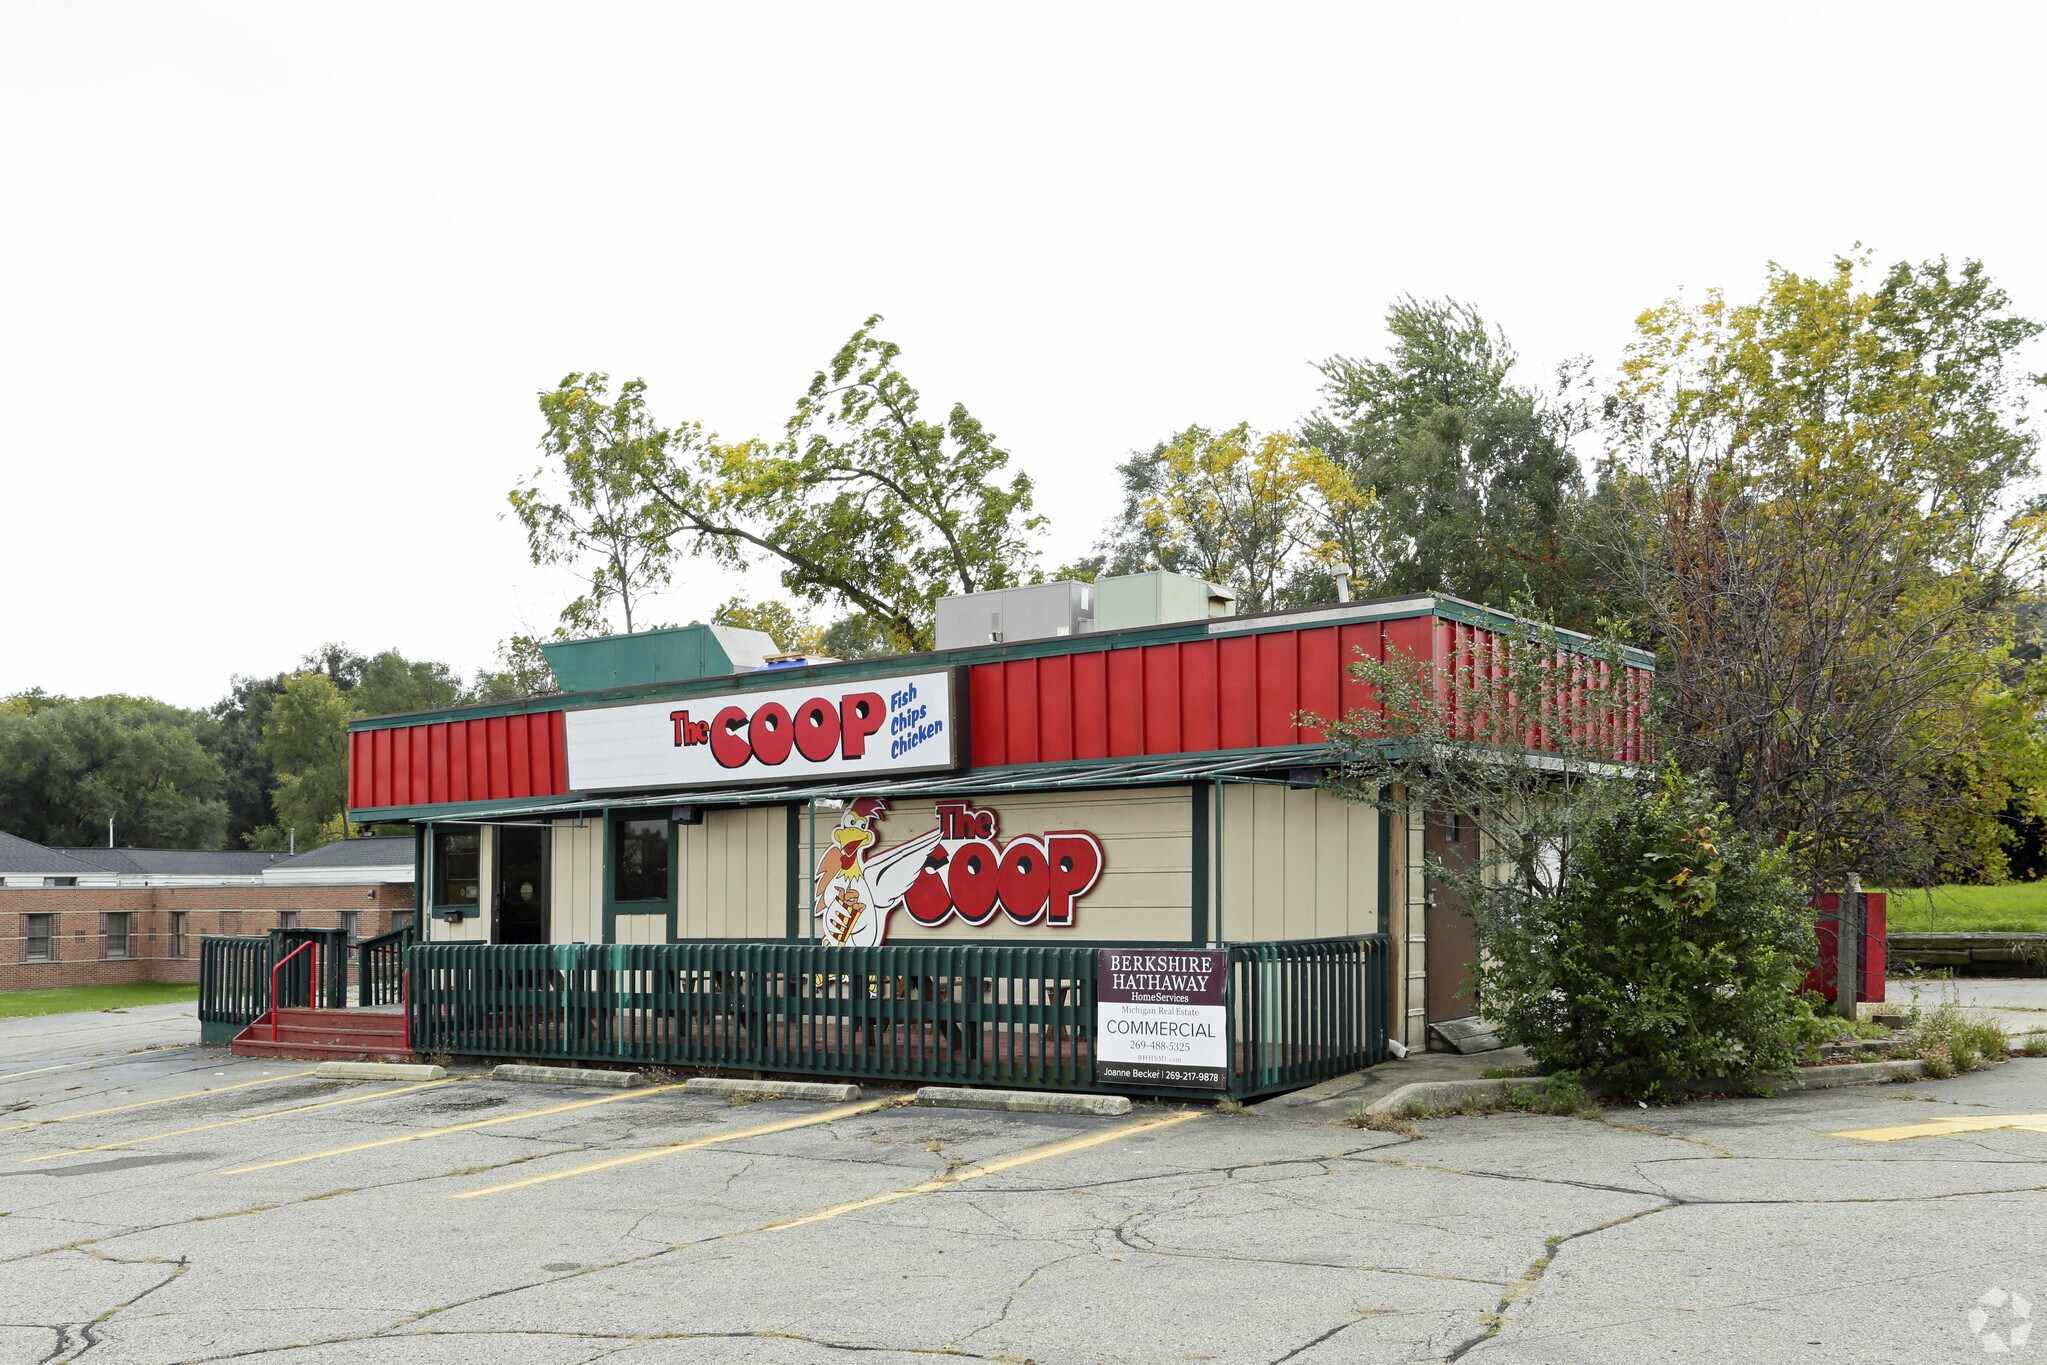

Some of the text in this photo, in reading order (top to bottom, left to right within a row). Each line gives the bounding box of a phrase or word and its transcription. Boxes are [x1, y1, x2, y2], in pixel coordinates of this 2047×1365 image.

[890, 682, 917, 713] Fish
[890, 704, 927, 736] Chips
[670, 691, 887, 769] The COOP
[890, 719, 943, 760] Chicken
[936, 803, 997, 841] The
[1110, 955, 1212, 973] BERKSHIRE
[1112, 973, 1209, 992] HATHAWAY
[1131, 991, 1189, 1003] HomeServices
[1121, 1006, 1200, 1017] Michigan Real Estate
[1106, 1019, 1216, 1038] COMMERCIAL
[1129, 1040, 1191, 1052] 269-488-5325
[1103, 1067, 1219, 1082] Joanne Becker 269-217-9878
